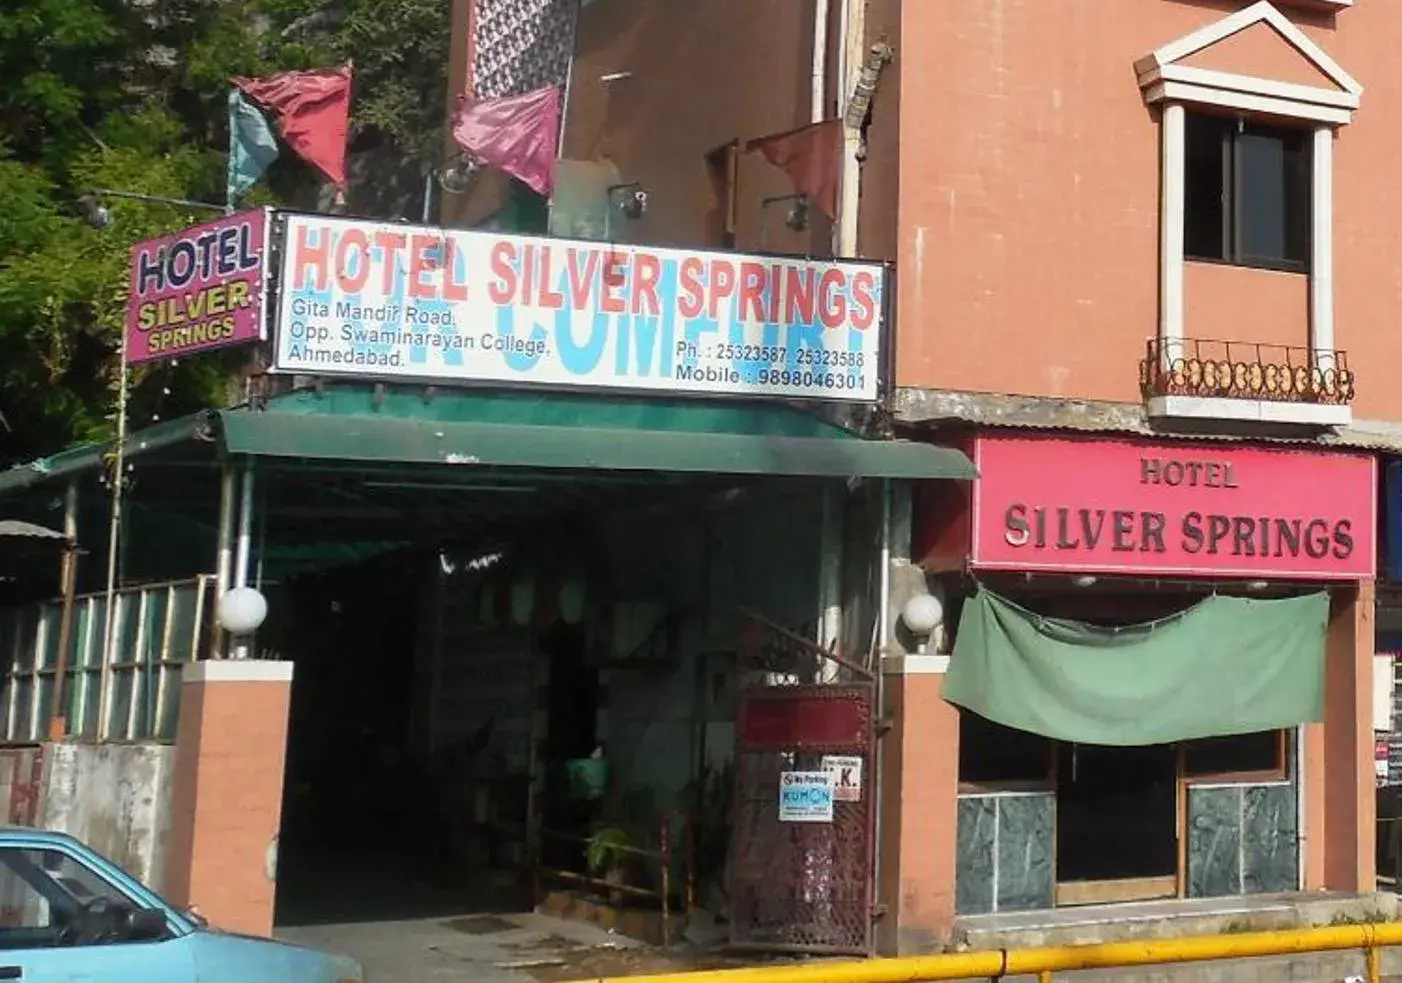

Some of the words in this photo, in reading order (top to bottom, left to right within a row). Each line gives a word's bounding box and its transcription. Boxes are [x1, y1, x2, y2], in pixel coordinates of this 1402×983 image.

[137, 222, 260, 296] HOTEL
[292, 224, 469, 302] HOTEL
[487, 240, 660, 316] SILVER
[677, 256, 875, 331] SPRINGS
[138, 279, 250, 332] SILVER
[291, 298, 329, 318] Gita
[335, 303, 400, 322] Mandir
[148, 316, 235, 354] SPRINGS
[290, 322, 334, 342] Opp.
[340, 325, 475, 352] Swaminarayan
[676, 364, 739, 384] Mobile
[758, 369, 865, 390] 9898046301
[1139, 458, 1239, 489] HOTEL
[1004, 504, 1166, 553] SILVER
[1181, 511, 1354, 560] SPRINGS
